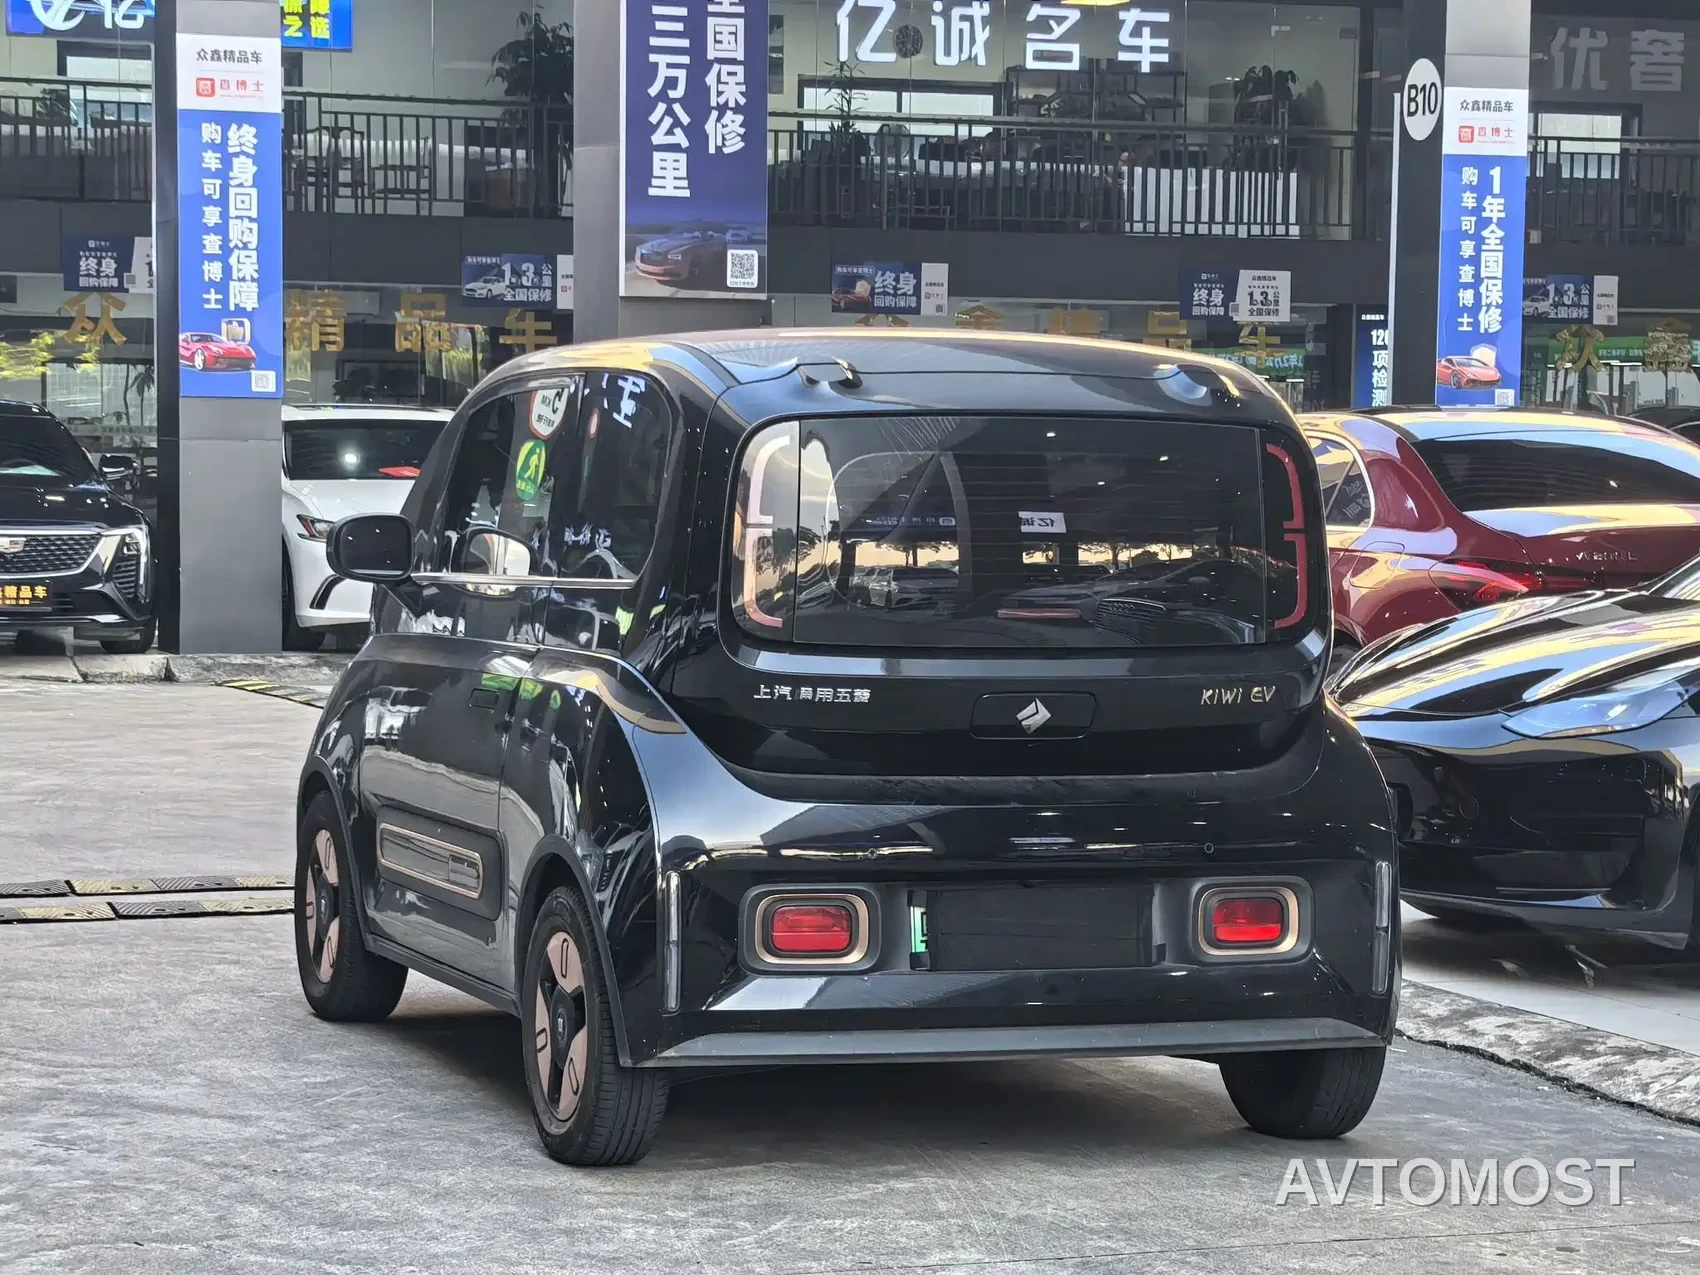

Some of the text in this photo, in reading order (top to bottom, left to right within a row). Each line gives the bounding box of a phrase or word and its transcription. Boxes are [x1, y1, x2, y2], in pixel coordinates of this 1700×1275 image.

[837, 0, 1170, 73] 亿诚名车
[647, 5, 691, 197] 三万公里
[1407, 82, 1438, 117] B10
[1460, 100, 1514, 112] 众鑫精品车
[201, 122, 223, 309] 购车可享查博士
[228, 123, 259, 312] 终身回购保障
[1457, 166, 1478, 331] 购车可享查博士
[1478, 166, 1505, 333] 1年全国保修
[80, 257, 117, 277] 终身
[874, 270, 917, 295] 终身
[503, 288, 552, 302] 全国保修
[874, 295, 917, 308] 回购保障
[1193, 288, 1224, 306] 终身
[1192, 306, 1225, 316] 回购保障
[1248, 308, 1280, 317] 全国保修
[1547, 306, 1589, 319] 全国保修
[1251, 686, 1276, 703] EV
